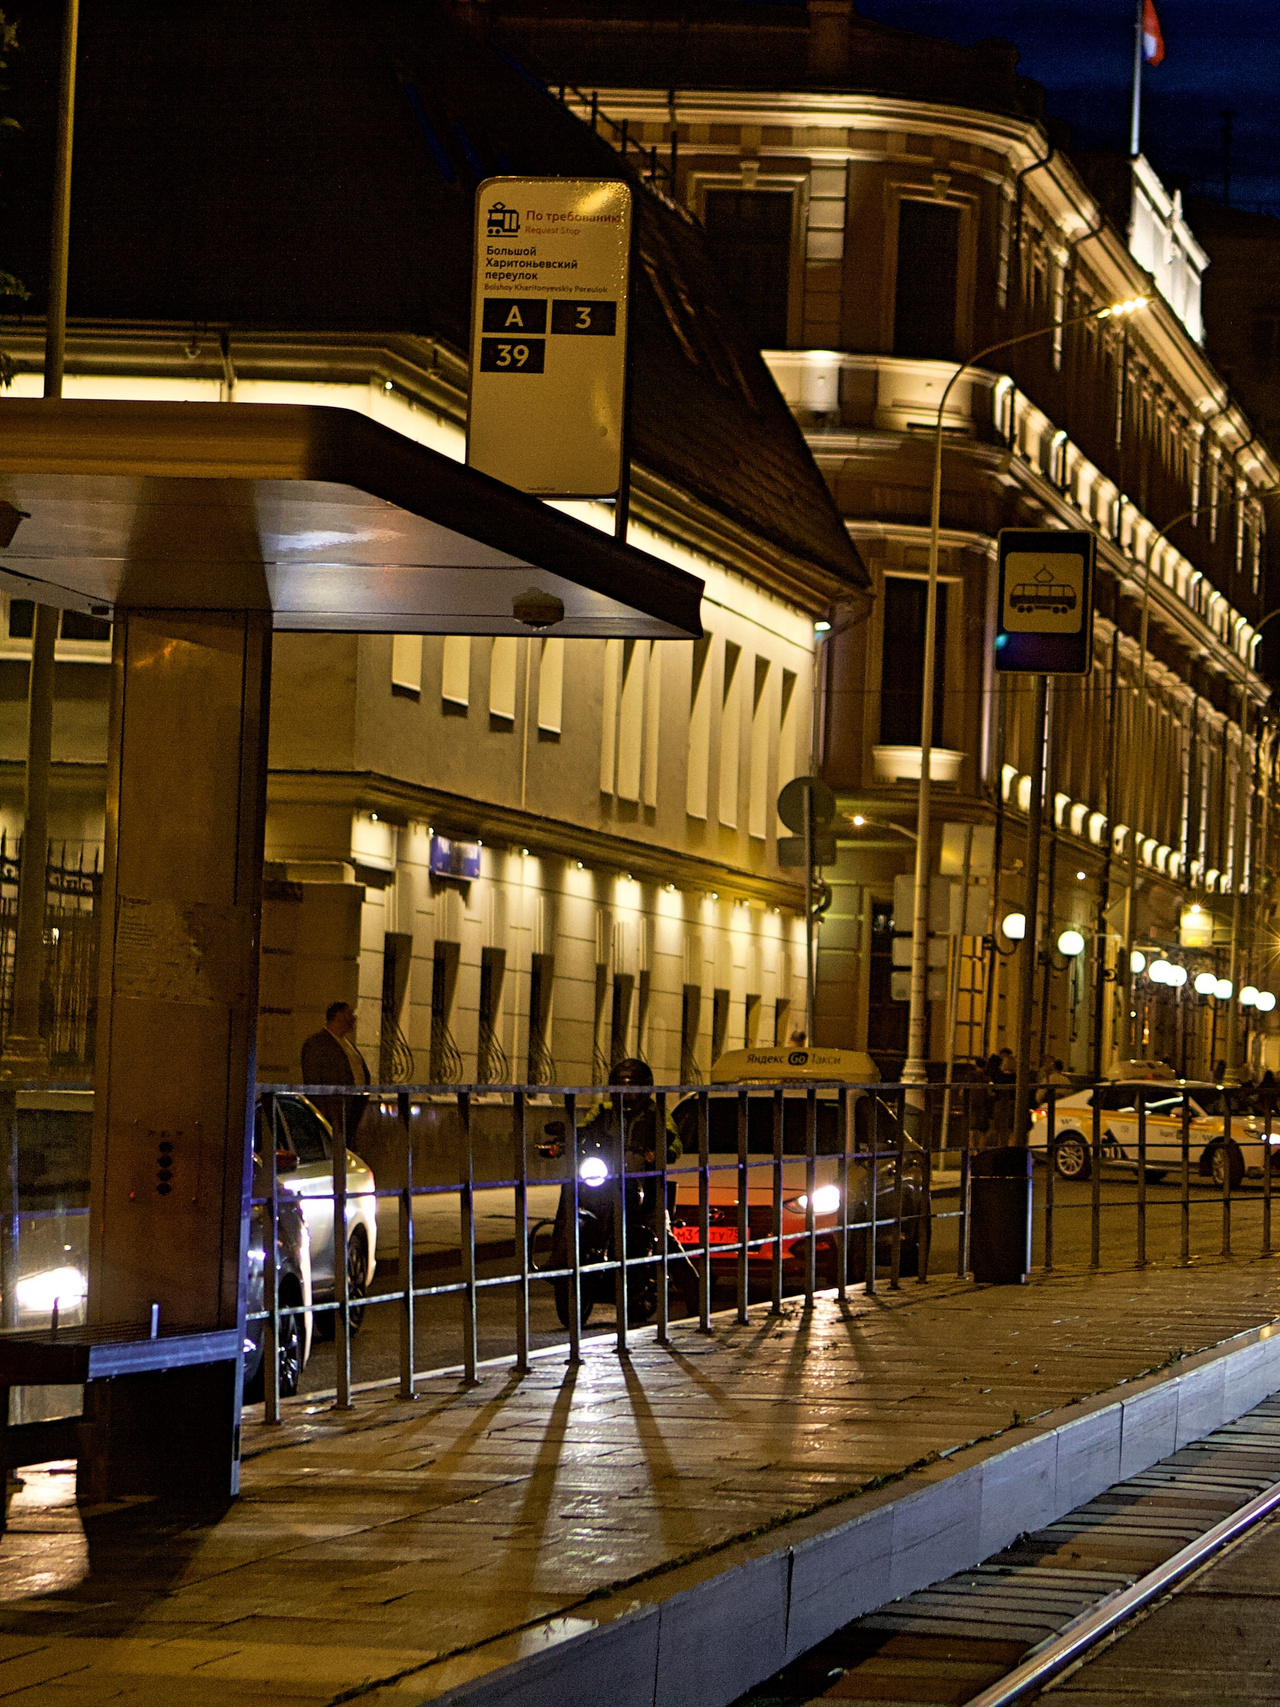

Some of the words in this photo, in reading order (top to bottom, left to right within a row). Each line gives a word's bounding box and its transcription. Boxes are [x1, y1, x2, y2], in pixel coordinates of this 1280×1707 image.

[526, 210, 543, 221] По
[546, 211, 622, 224] требованию
[525, 226, 559, 235] Request
[560, 226, 580, 235] Stop
[486, 245, 537, 256] Большой
[485, 258, 578, 270] Харитоньевский
[485, 271, 538, 282] переулок
[484, 283, 512, 292] Bolshoy
[574, 285, 608, 294] Pereulok
[504, 305, 524, 327] А
[575, 306, 592, 329] 3
[496, 344, 530, 367] 39
[746, 1053, 784, 1065] Яндекс
[791, 1052, 807, 1064] Go
